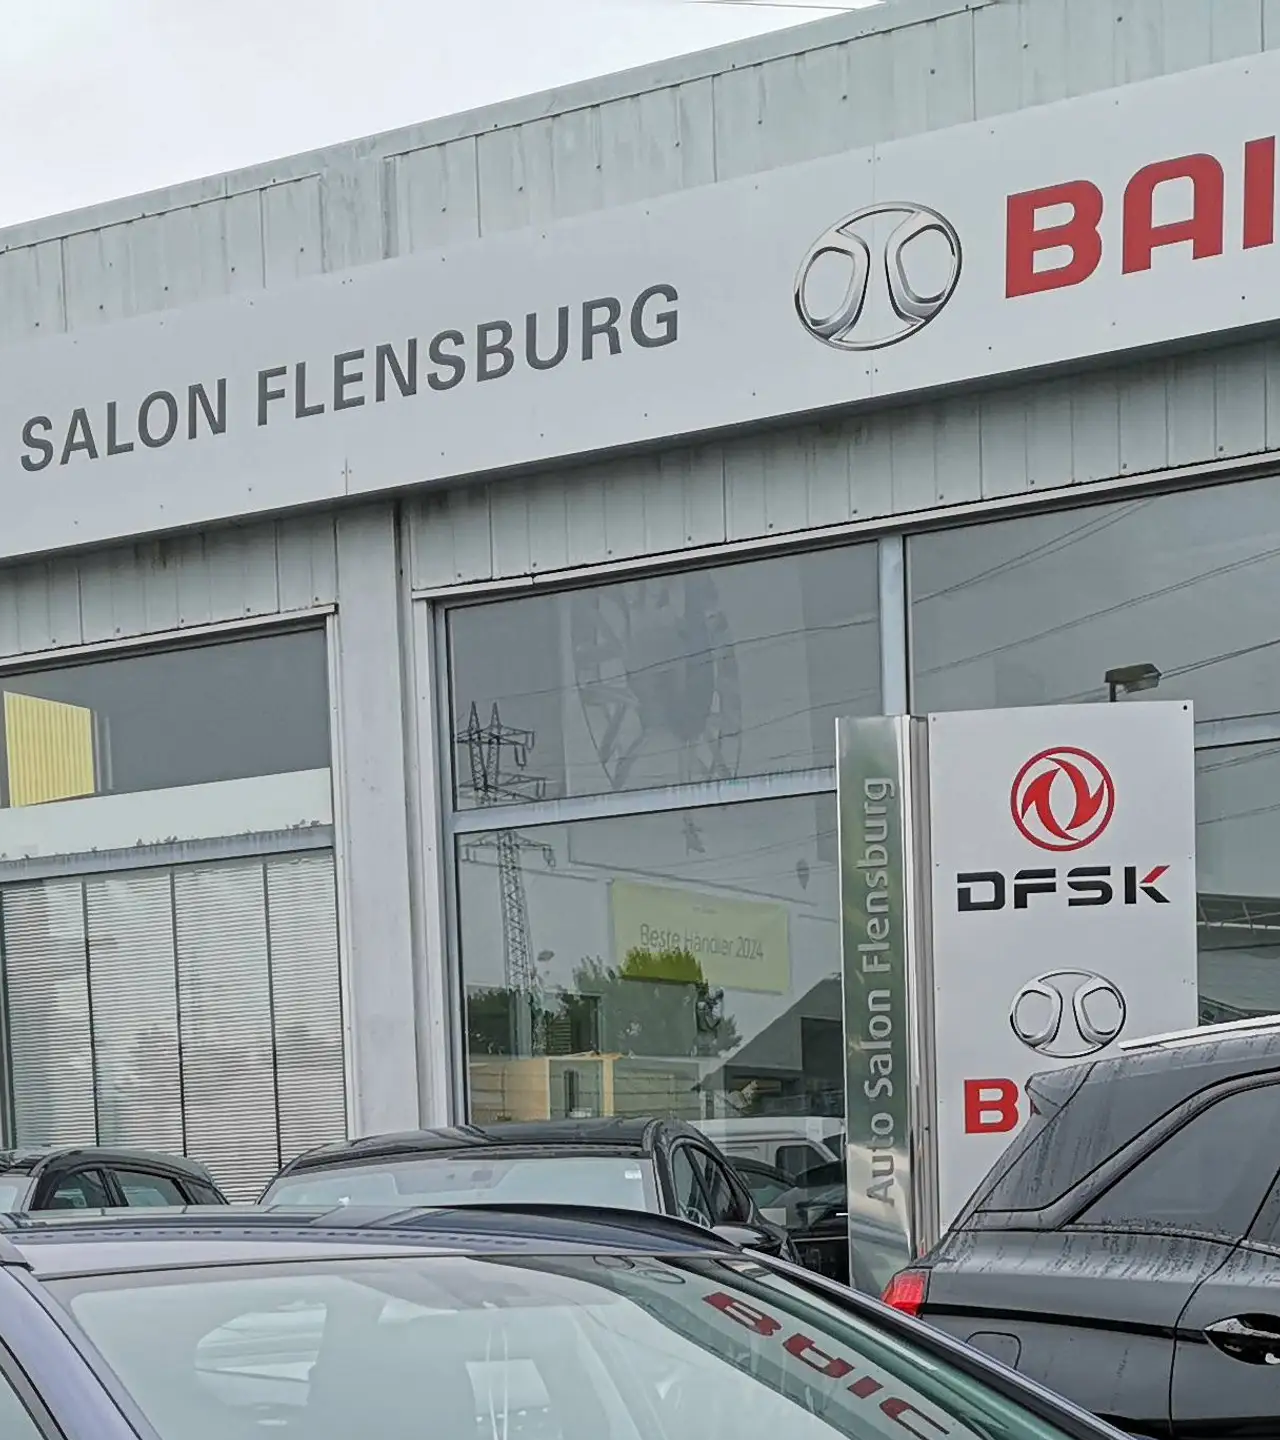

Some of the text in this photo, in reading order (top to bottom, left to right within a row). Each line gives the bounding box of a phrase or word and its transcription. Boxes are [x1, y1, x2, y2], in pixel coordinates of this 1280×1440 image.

[20, 376, 228, 472] SALON
[257, 283, 681, 426] FLENSBURG
[957, 865, 1170, 912] DFSK
[858, 777, 895, 1206] Auto Salon Flensburg
